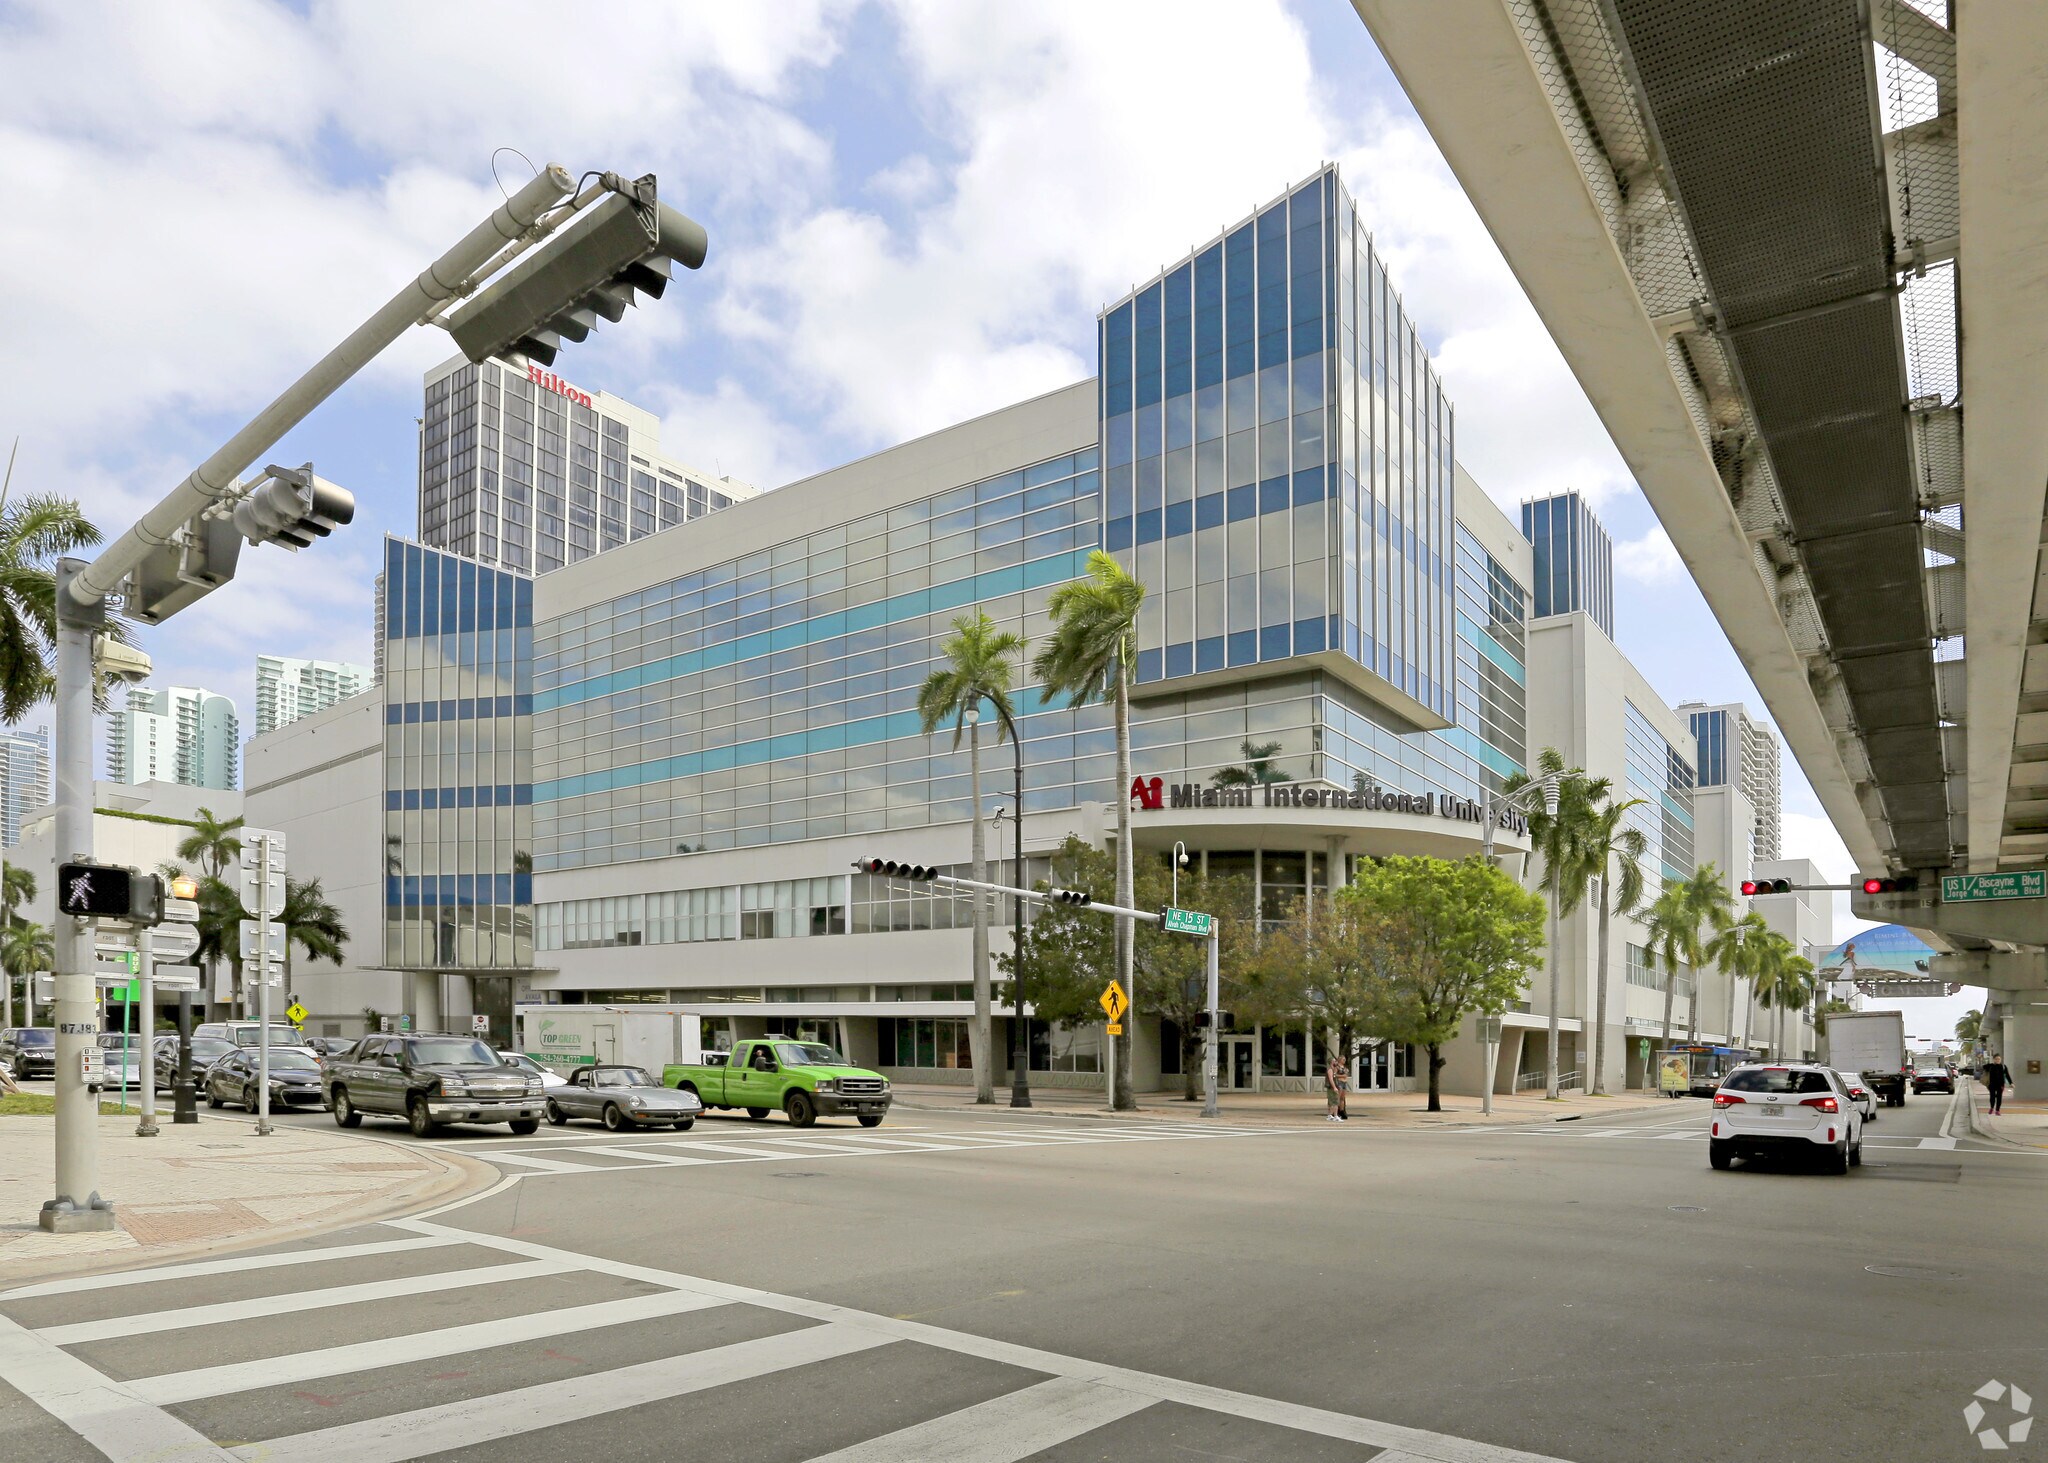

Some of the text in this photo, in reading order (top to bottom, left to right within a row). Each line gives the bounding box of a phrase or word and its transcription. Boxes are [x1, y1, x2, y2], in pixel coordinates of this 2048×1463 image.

[528, 365, 592, 408] Hilton
[1170, 783, 1253, 807] Miami
[1264, 782, 1434, 815] International
[1947, 879, 1959, 890] US
[2022, 875, 2041, 886] Blvd
[1947, 886, 2041, 899] Jorge Mas Canosa Blvd
[1172, 911, 1205, 925] NE 15 ST
[543, 1034, 582, 1043] TOP GREEN
